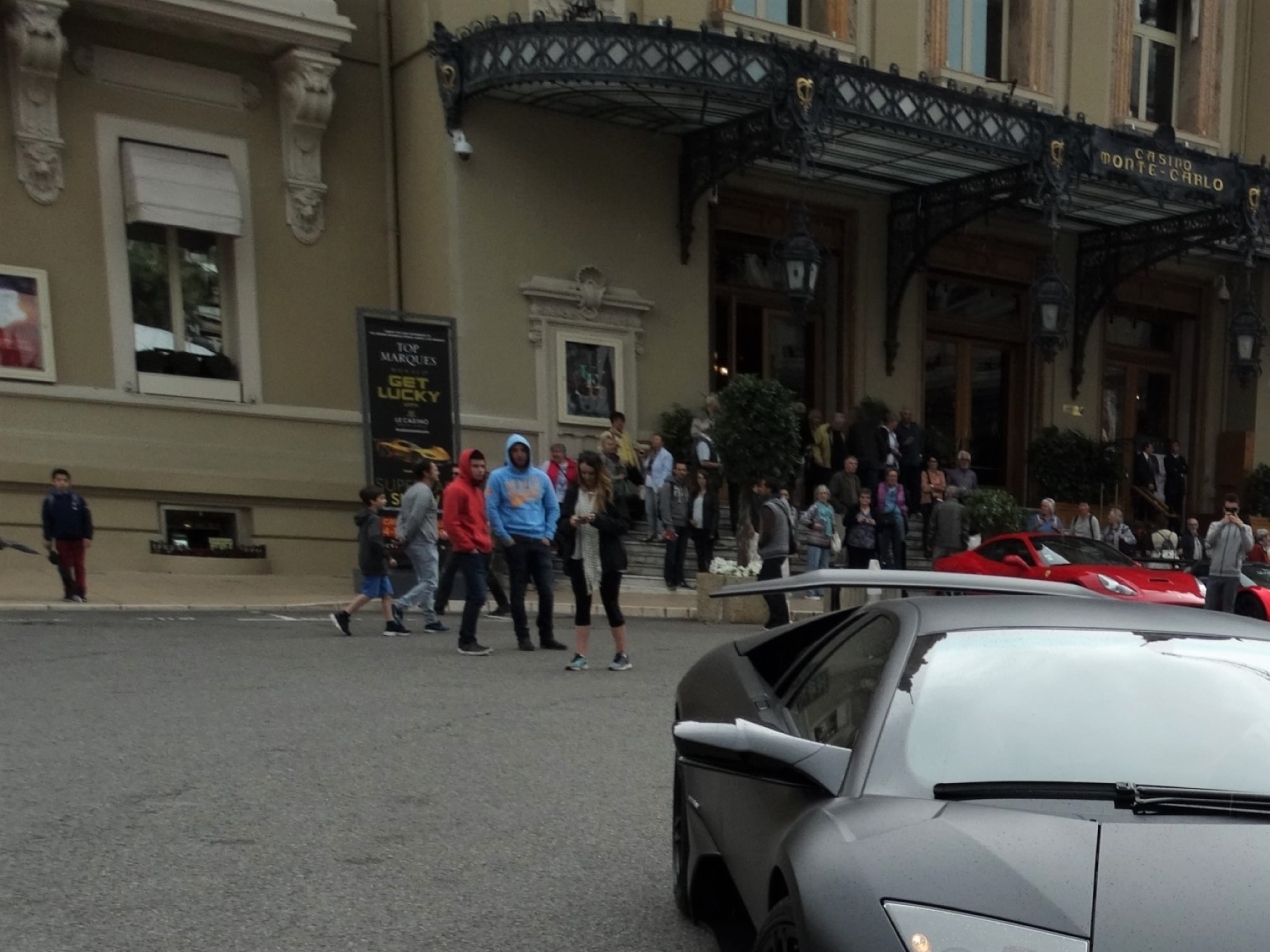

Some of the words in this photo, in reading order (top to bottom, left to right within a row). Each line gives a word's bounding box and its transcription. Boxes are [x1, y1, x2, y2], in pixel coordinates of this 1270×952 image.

[1134, 148, 1192, 171] CASINO
[1100, 151, 1224, 191] MONTE-CARLO
[396, 342, 420, 354] TOP
[380, 351, 438, 367] MARQUES
[388, 374, 429, 389] GET
[377, 386, 441, 403] LUCKY
